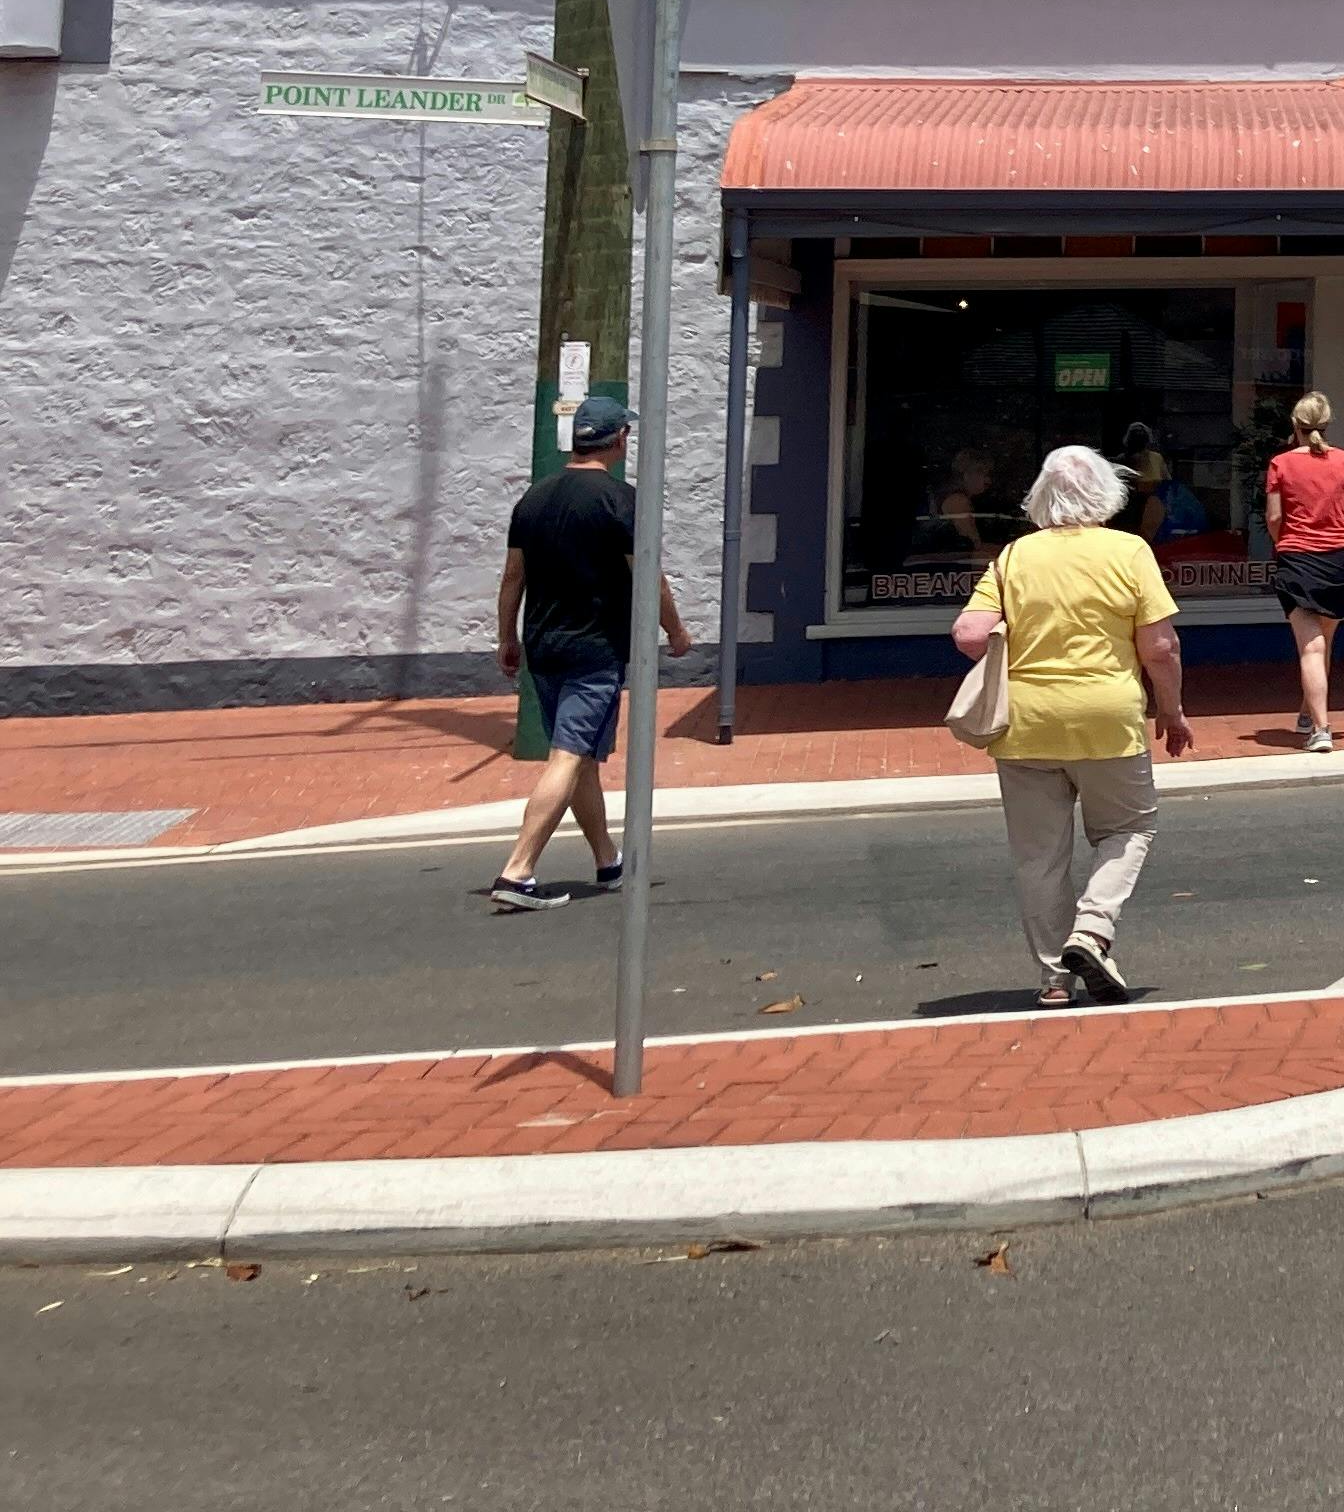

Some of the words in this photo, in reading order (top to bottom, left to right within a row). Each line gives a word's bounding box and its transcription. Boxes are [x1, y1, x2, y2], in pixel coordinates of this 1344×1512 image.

[264, 85, 350, 107] POINT
[356, 88, 482, 112] LEANDER
[487, 93, 506, 105] DR
[1056, 368, 1109, 387] OPEN
